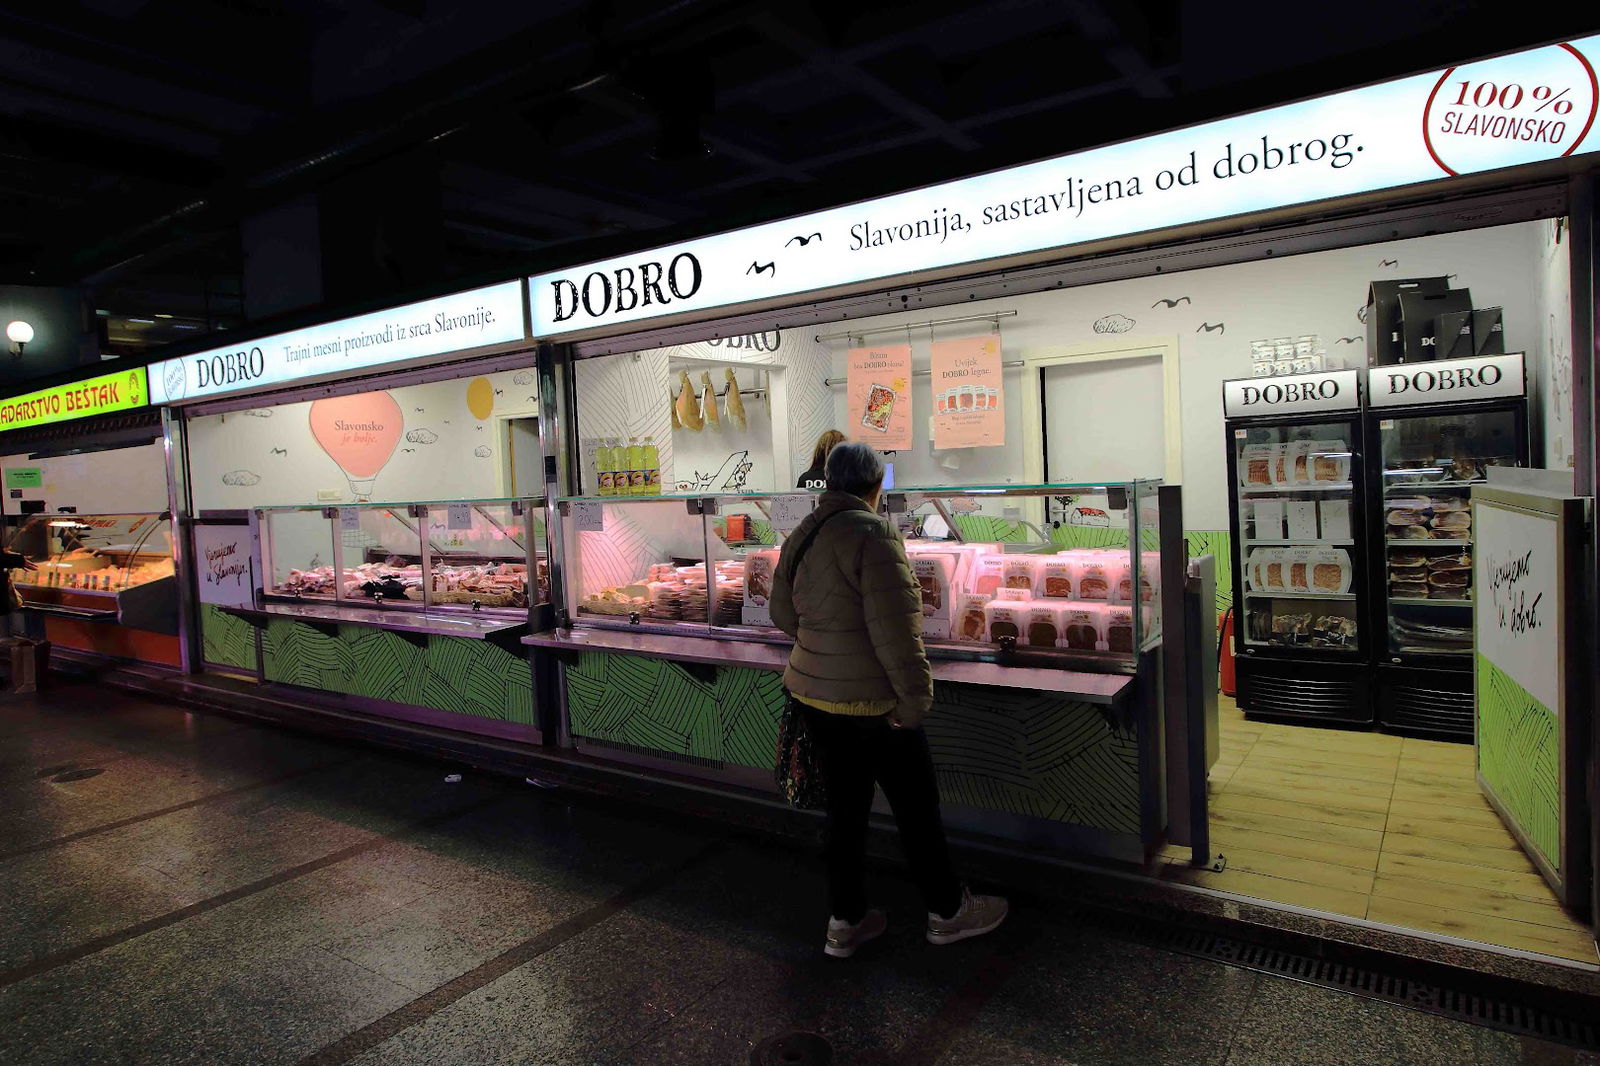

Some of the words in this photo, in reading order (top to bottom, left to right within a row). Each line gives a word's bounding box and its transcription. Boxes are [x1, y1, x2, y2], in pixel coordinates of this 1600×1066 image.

[1441, 111, 1567, 144] SLAVONSKO
[849, 207, 972, 251] Slavonija,
[982, 178, 1144, 225] sastavljena
[1155, 153, 1200, 191] od
[1213, 132, 1364, 179] dobrog.
[551, 252, 703, 323] DOBRO
[283, 345, 311, 364] Trajni
[313, 337, 341, 357] mesni
[344, 324, 394, 356] proizvodi
[397, 325, 407, 342] iz
[409, 322, 432, 338] srca
[434, 306, 496, 332] Slavonije.
[196, 347, 265, 389] DOBRO
[942, 368, 969, 379] DOBRO
[1388, 364, 1502, 395] DOBRO
[66, 381, 120, 413] BEŠTAK
[1242, 379, 1339, 406] DOBRO
[334, 420, 384, 432] Slavonsko
